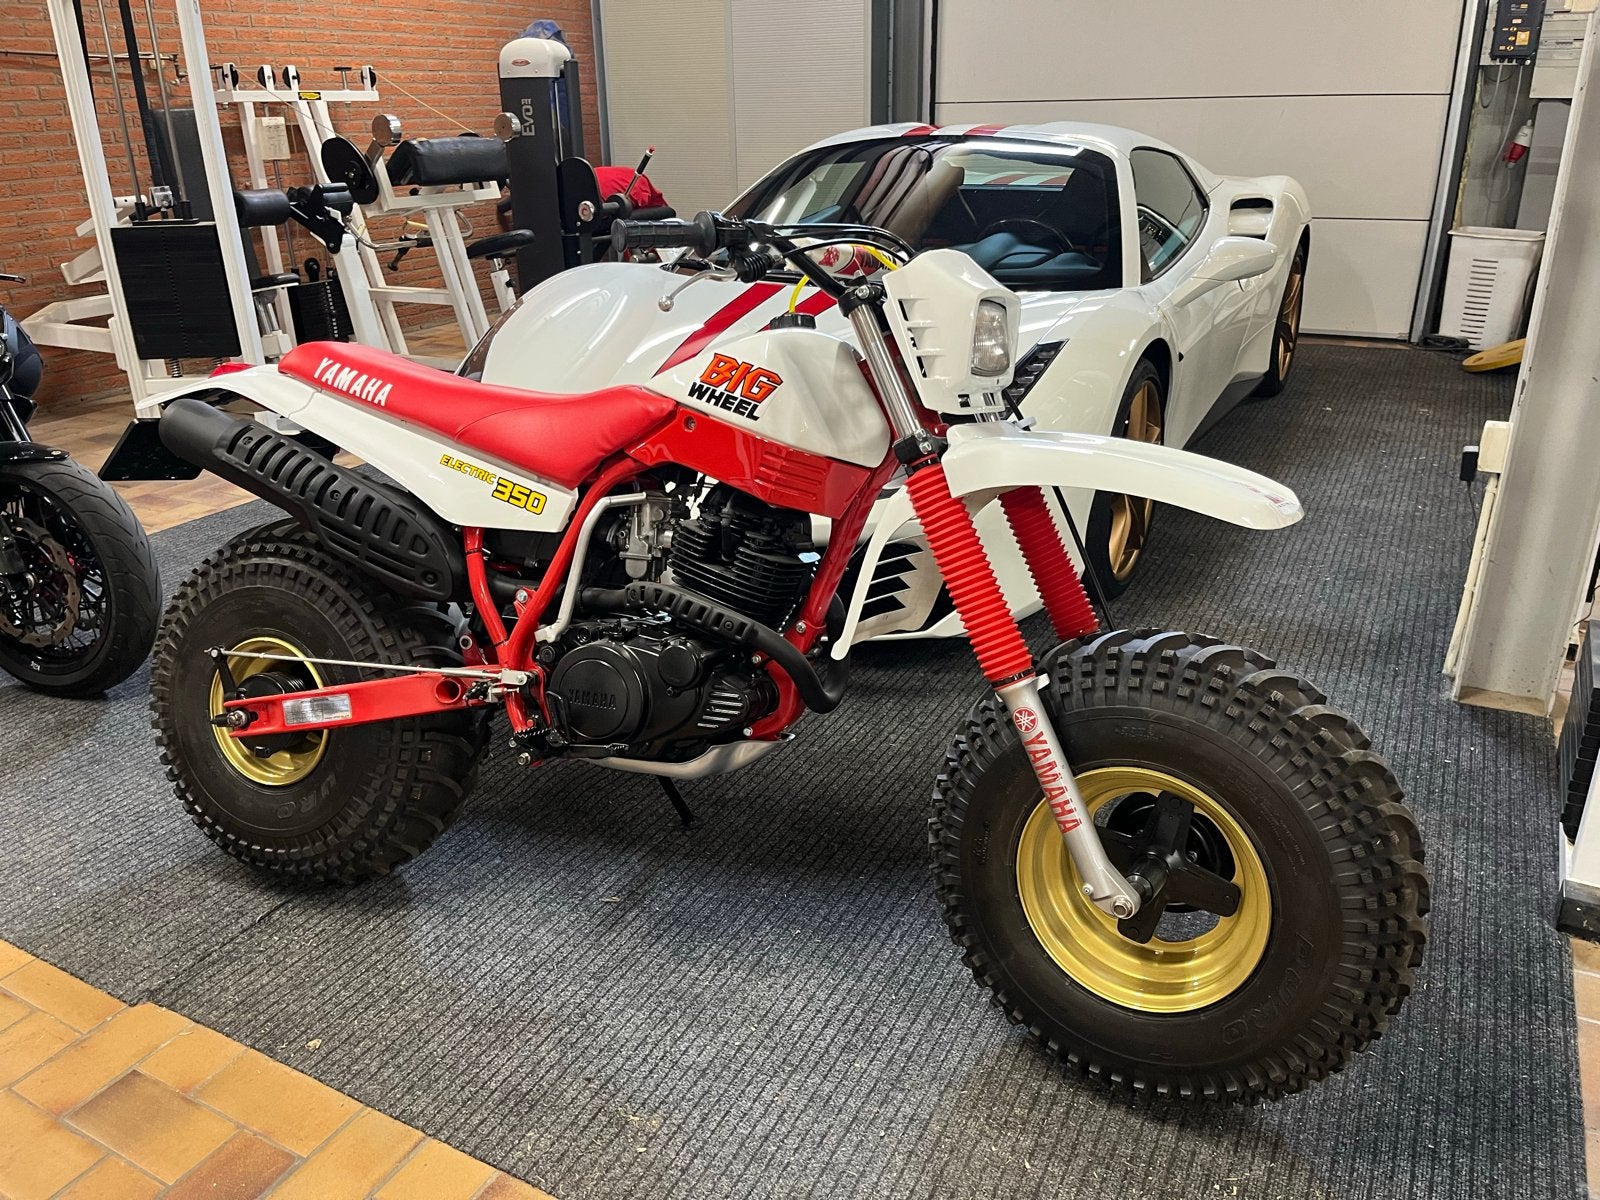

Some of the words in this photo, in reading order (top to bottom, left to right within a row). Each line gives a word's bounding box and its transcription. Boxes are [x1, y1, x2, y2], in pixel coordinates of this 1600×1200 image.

[313, 357, 393, 407] YAMAHA
[687, 381, 760, 421] WHEEL
[699, 353, 784, 404] BIG
[440, 454, 497, 485] ELECTRIC
[492, 476, 548, 515] 350
[568, 688, 616, 710] YAMAHA
[1024, 731, 1082, 834] YAMAHA
